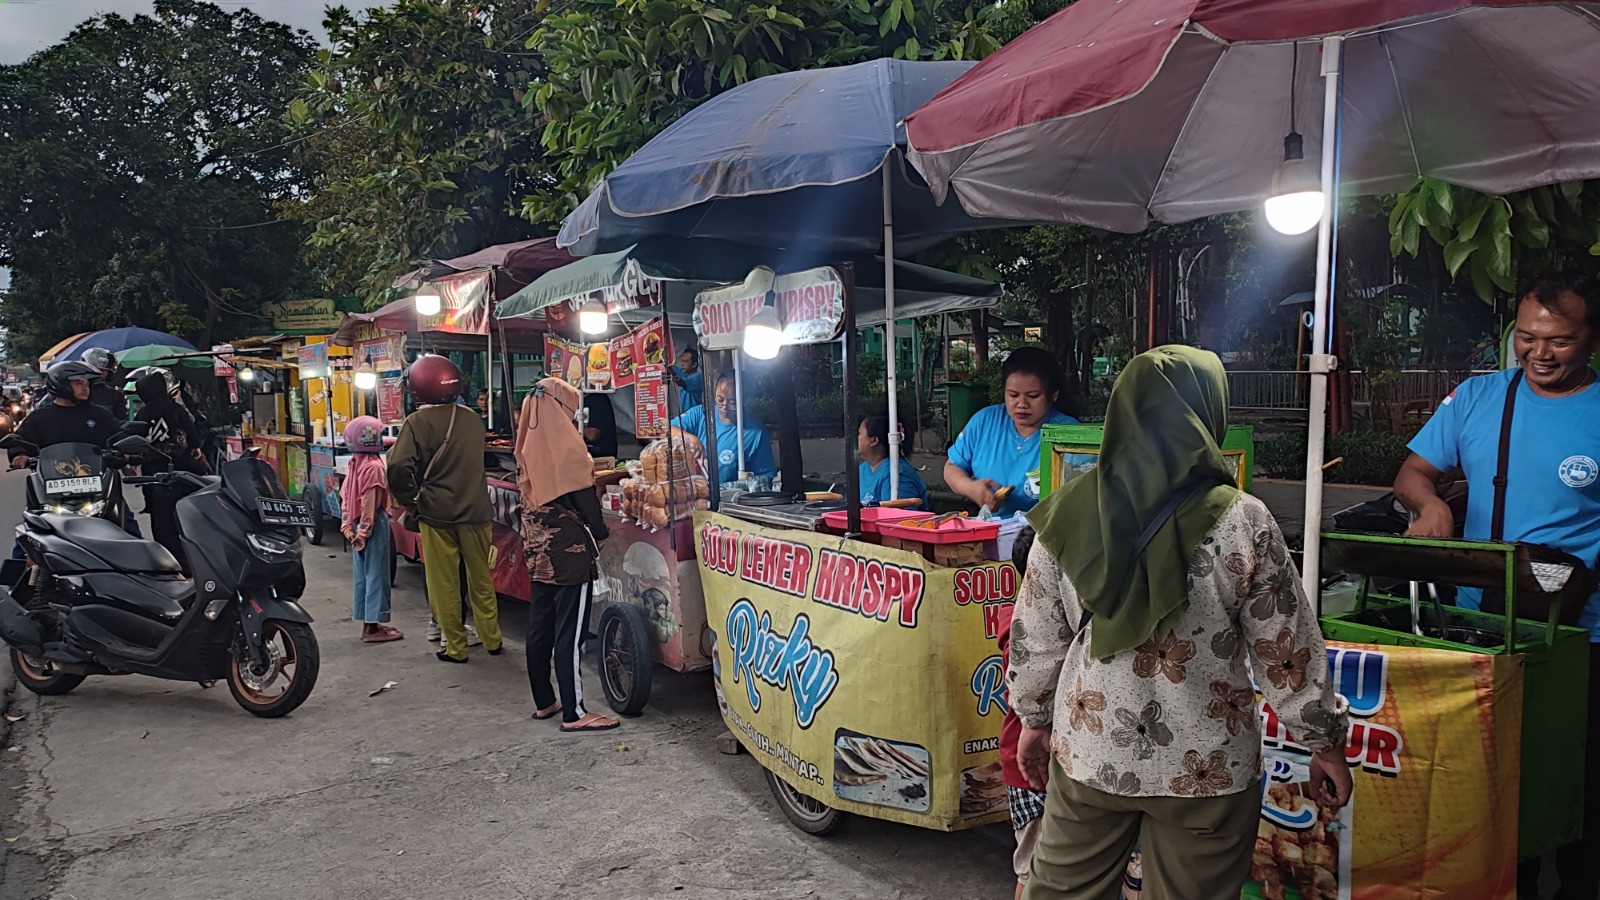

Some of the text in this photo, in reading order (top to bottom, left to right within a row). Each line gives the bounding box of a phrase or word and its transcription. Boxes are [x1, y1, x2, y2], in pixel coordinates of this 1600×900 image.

[701, 301, 733, 336] SOLO
[776, 282, 836, 325] KRISPY
[700, 521, 741, 576] SOLO
[740, 534, 813, 598] LEKER
[812, 546, 925, 629] KRISPY
[954, 564, 1017, 606] SOLO
[726, 597, 840, 731] Rizky
